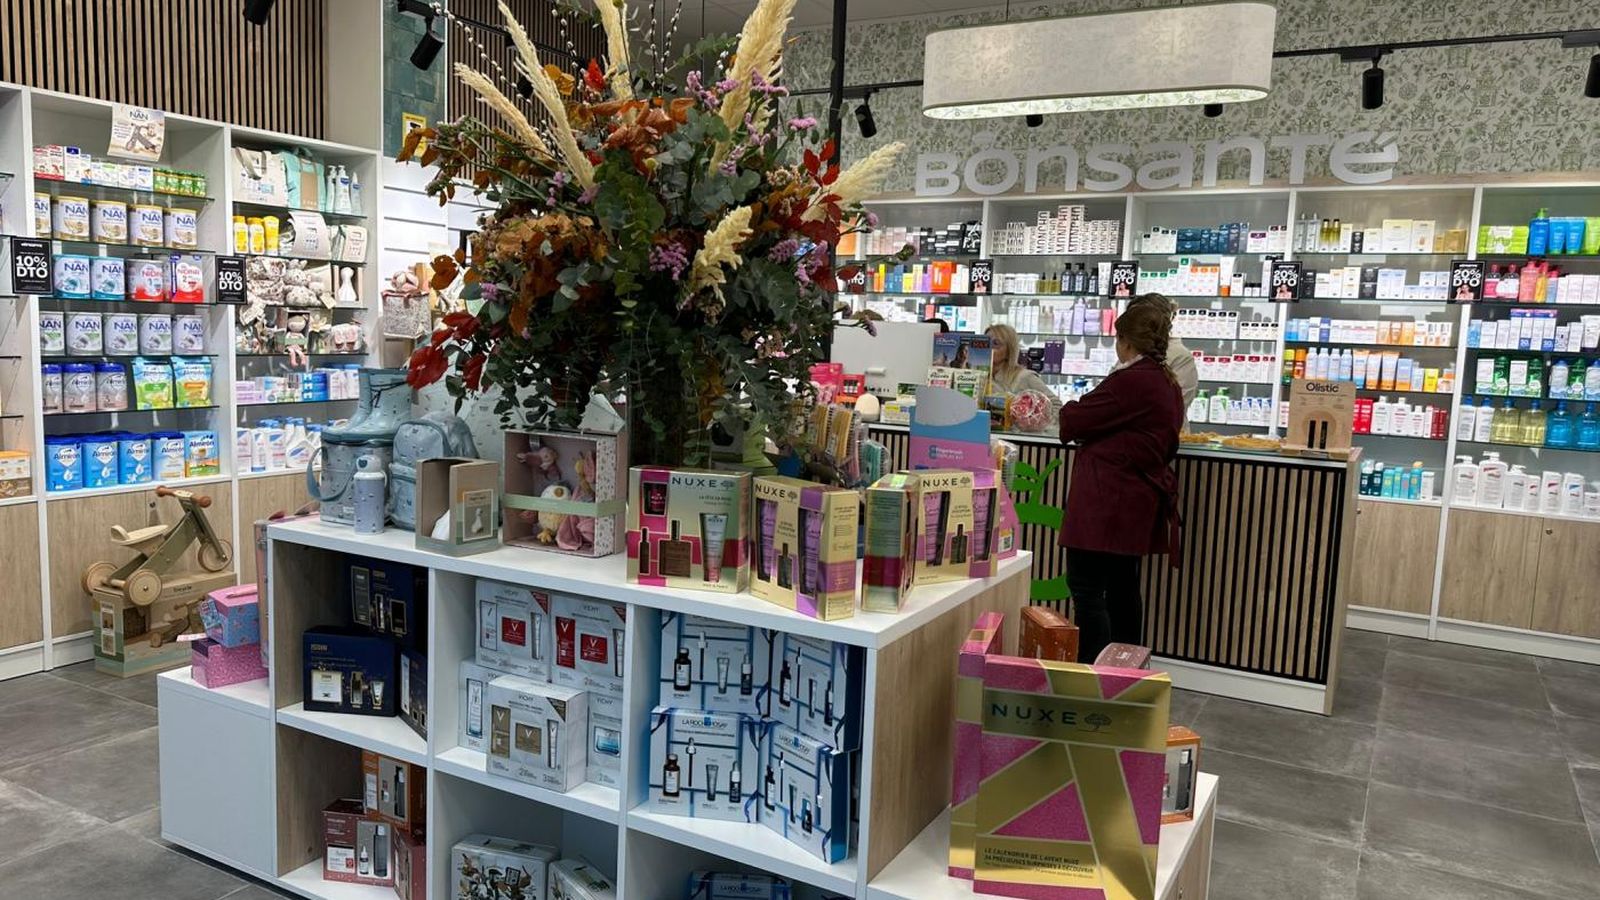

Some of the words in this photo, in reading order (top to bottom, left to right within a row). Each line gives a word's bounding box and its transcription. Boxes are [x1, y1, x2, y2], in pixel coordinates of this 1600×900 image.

[129, 111, 149, 121] NAN
[16, 255, 48, 269] 10%
[16, 267, 48, 279] DTO
[219, 271, 243, 282] 10%
[971, 267, 992, 276] 20%
[1113, 269, 1136, 279] 20%
[1273, 269, 1298, 280] 20%
[1453, 269, 1482, 280] 20%
[971, 274, 990, 282] DTO
[1113, 277, 1134, 285] DTO
[1273, 278, 1296, 287] DTO
[1453, 278, 1480, 287] DTO
[219, 280, 243, 291] DTO
[75, 321, 100, 331] NAN
[1305, 382, 1339, 393] Olistic
[671, 477, 718, 488] NUXE
[922, 477, 958, 488] NUXE
[755, 484, 786, 499] NUXE
[991, 703, 1078, 726] NUXE
